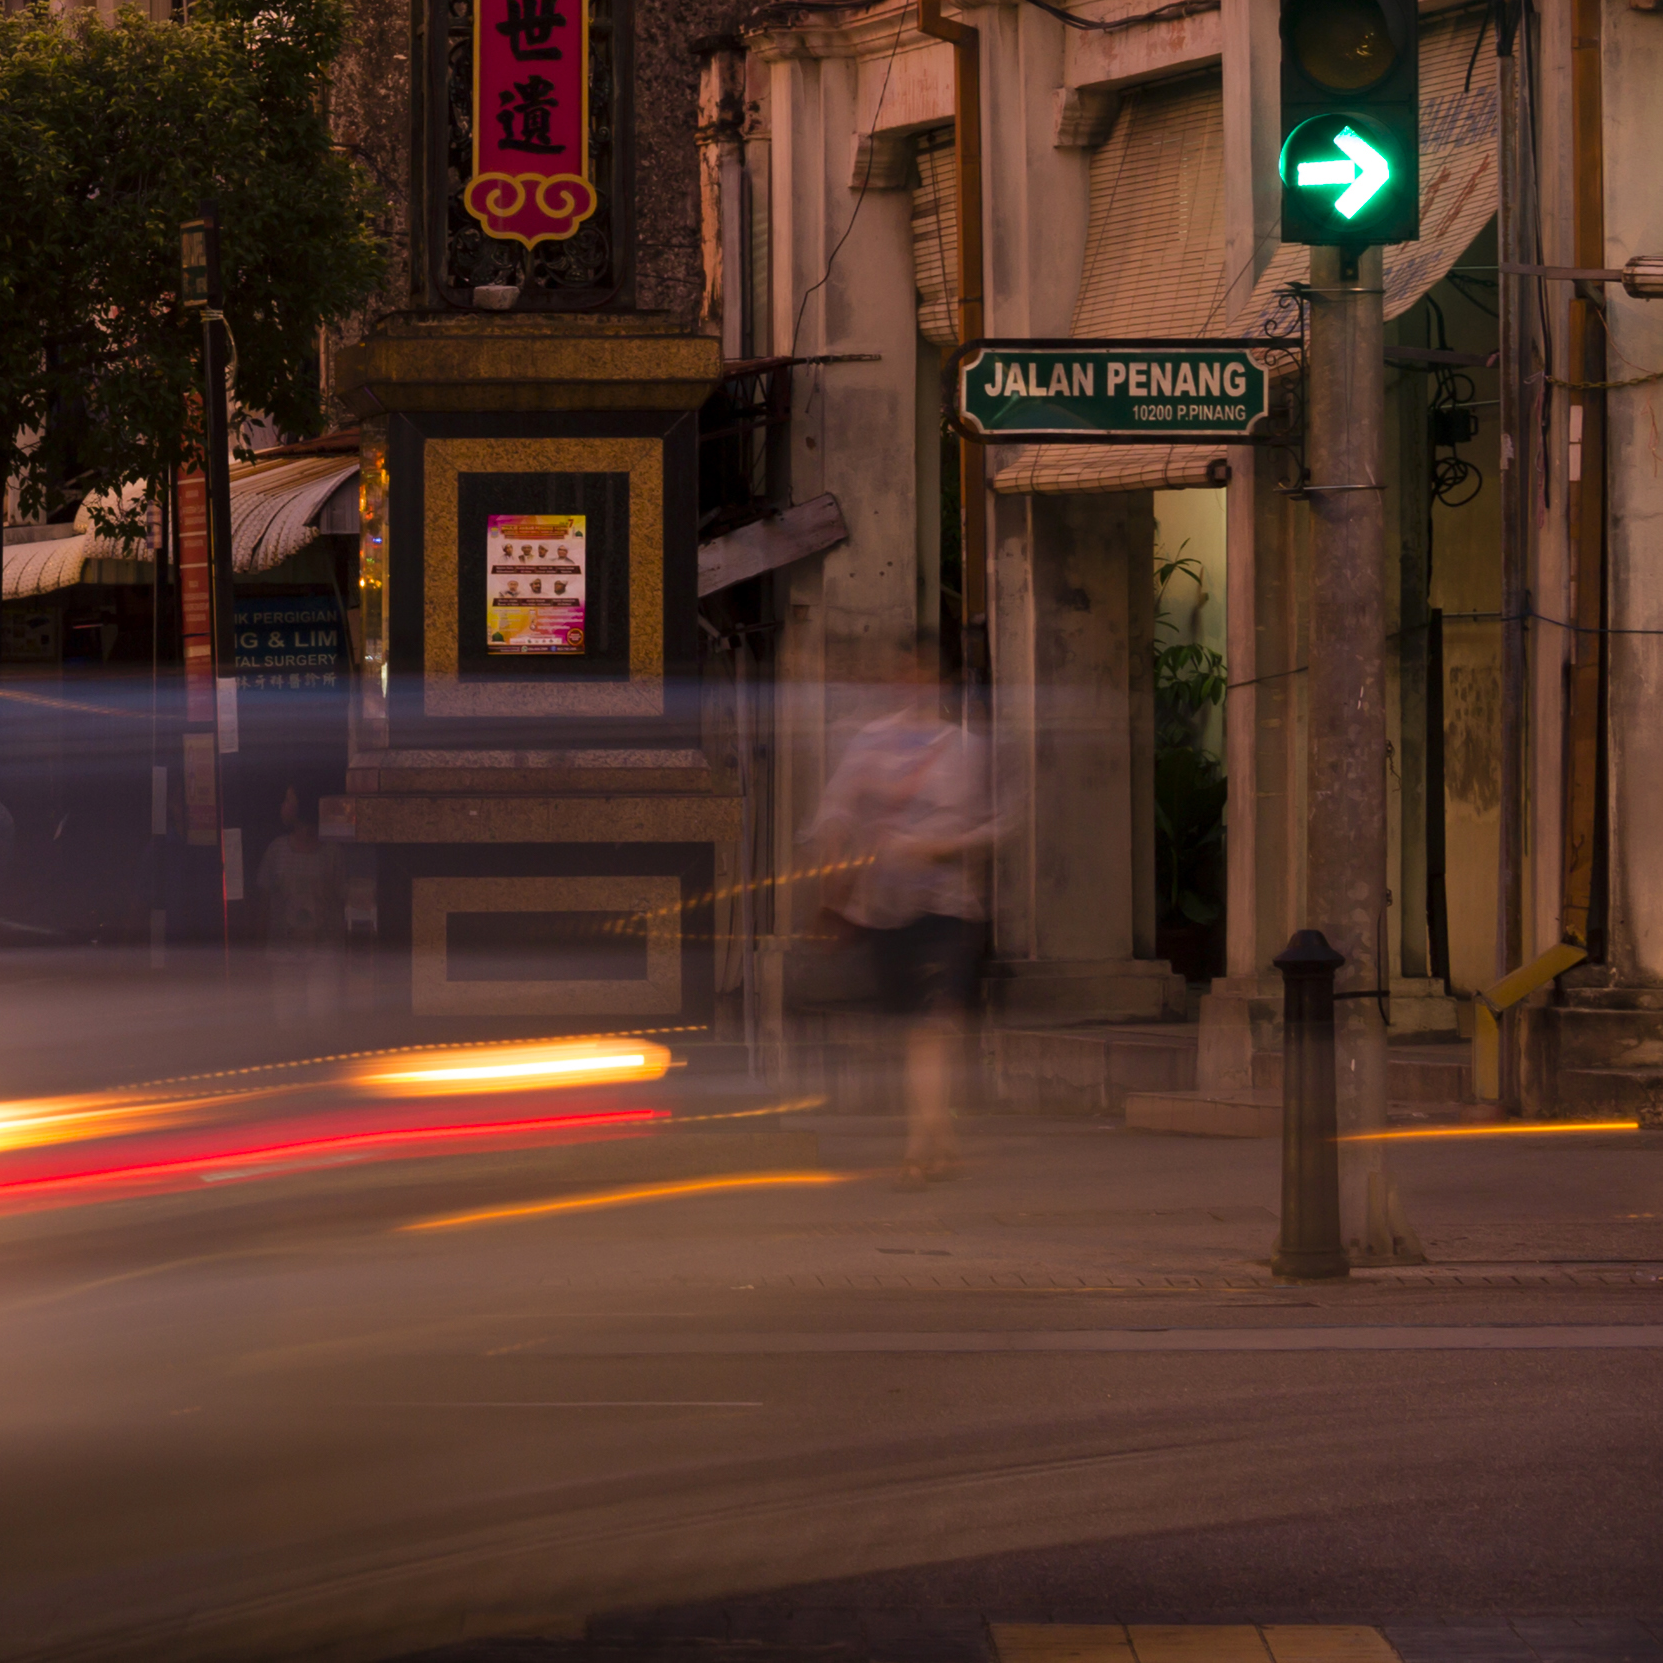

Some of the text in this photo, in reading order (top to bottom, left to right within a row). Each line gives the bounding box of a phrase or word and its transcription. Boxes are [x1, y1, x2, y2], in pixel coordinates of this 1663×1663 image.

[983, 361, 1247, 398] JALAN PENANG
[1132, 404, 1247, 422] 10200 P.PINANG
[253, 610, 337, 625] PERGIGIAN
[294, 629, 338, 648] LIM
[264, 653, 337, 667] SURGERY
